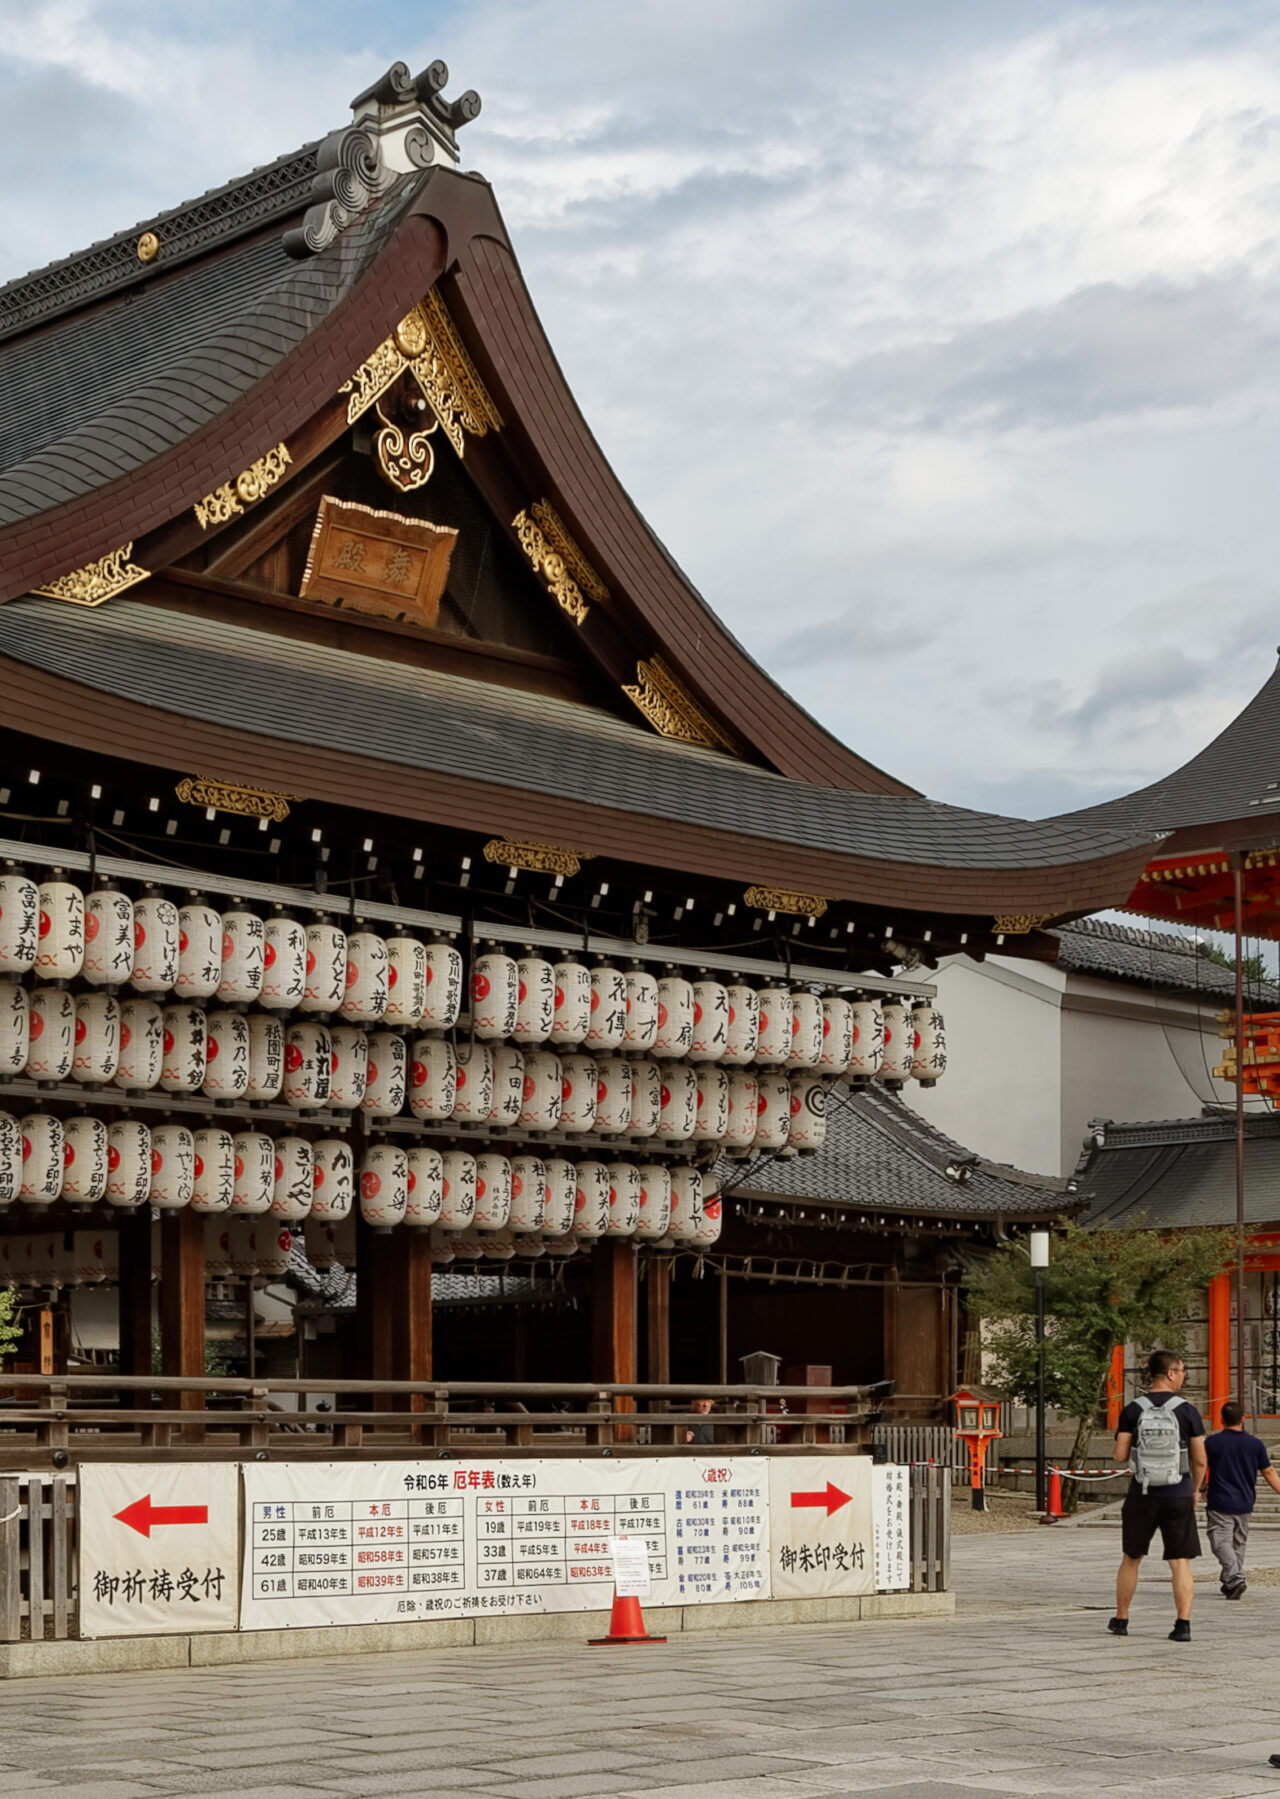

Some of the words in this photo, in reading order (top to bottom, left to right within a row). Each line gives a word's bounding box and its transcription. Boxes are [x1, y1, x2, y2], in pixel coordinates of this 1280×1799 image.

[14, 883, 37, 961] 富美祐
[63, 892, 83, 963] たまや
[113, 897, 132, 972] 富美代
[202, 913, 221, 983] いし初
[286, 929, 305, 997] 利きみ
[370, 939, 388, 1015] ふく葉
[540, 966, 554, 1033] まつもと
[713, 989, 728, 1045] えん
[389, 1039, 405, 1107] 富久家
[683, 1070, 696, 1132] ちもと
[717, 1071, 728, 1133] ちもと
[40, 1117, 60, 1196] あおぞら印刷
[84, 1121, 105, 1199] あおぞら印刷
[128, 1125, 148, 1203] あおぞら印刷
[215, 1134, 233, 1206] 井上文太
[256, 1138, 273, 1204] 西川菊人
[688, 1173, 702, 1230] カトレヤ
[403, 1474, 449, 1491] 令和6年
[453, 1470, 495, 1490] 厄年表
[497, 1473, 536, 1489] (数え年)
[369, 1503, 391, 1517] 本厄
[425, 1502, 447, 1515] 後厄
[485, 1501, 505, 1513] 女性
[528, 1500, 549, 1512] 前厄
[580, 1498, 600, 1511] 本厄
[629, 1497, 650, 1509] 後厄
[263, 1505, 286, 1519] 男性
[312, 1505, 335, 1519] 前厄
[413, 1523, 458, 1536] 平成11年生
[485, 1521, 505, 1534] 19歳
[517, 1520, 561, 1532] 平成19年生
[571, 1519, 610, 1531] 平成18年生
[619, 1517, 661, 1529] 平成17年生
[262, 1527, 286, 1542] 25歳
[298, 1527, 347, 1541] 平成13年生
[358, 1525, 403, 1538] 平成12年生
[412, 1547, 459, 1561] 昭和57年生
[483, 1545, 506, 1558] 33歳
[519, 1543, 558, 1555] 平成5年生
[574, 1542, 608, 1554] 平成4年生
[261, 1553, 286, 1567] 42歳
[298, 1552, 348, 1566] 昭和59年生
[357, 1550, 404, 1563] 昭和58年生
[780, 1542, 865, 1574] 御朱印受付
[412, 1571, 459, 1585] 昭和38年生
[484, 1569, 507, 1581] 37歳
[517, 1567, 562, 1580] 昭和64年生
[571, 1565, 612, 1577] 昭和63年生
[92, 1567, 225, 1606] 御祈祷受付
[260, 1578, 287, 1592] 61歳
[297, 1578, 348, 1591] 昭和40年生
[357, 1574, 404, 1588] 昭和39年生
